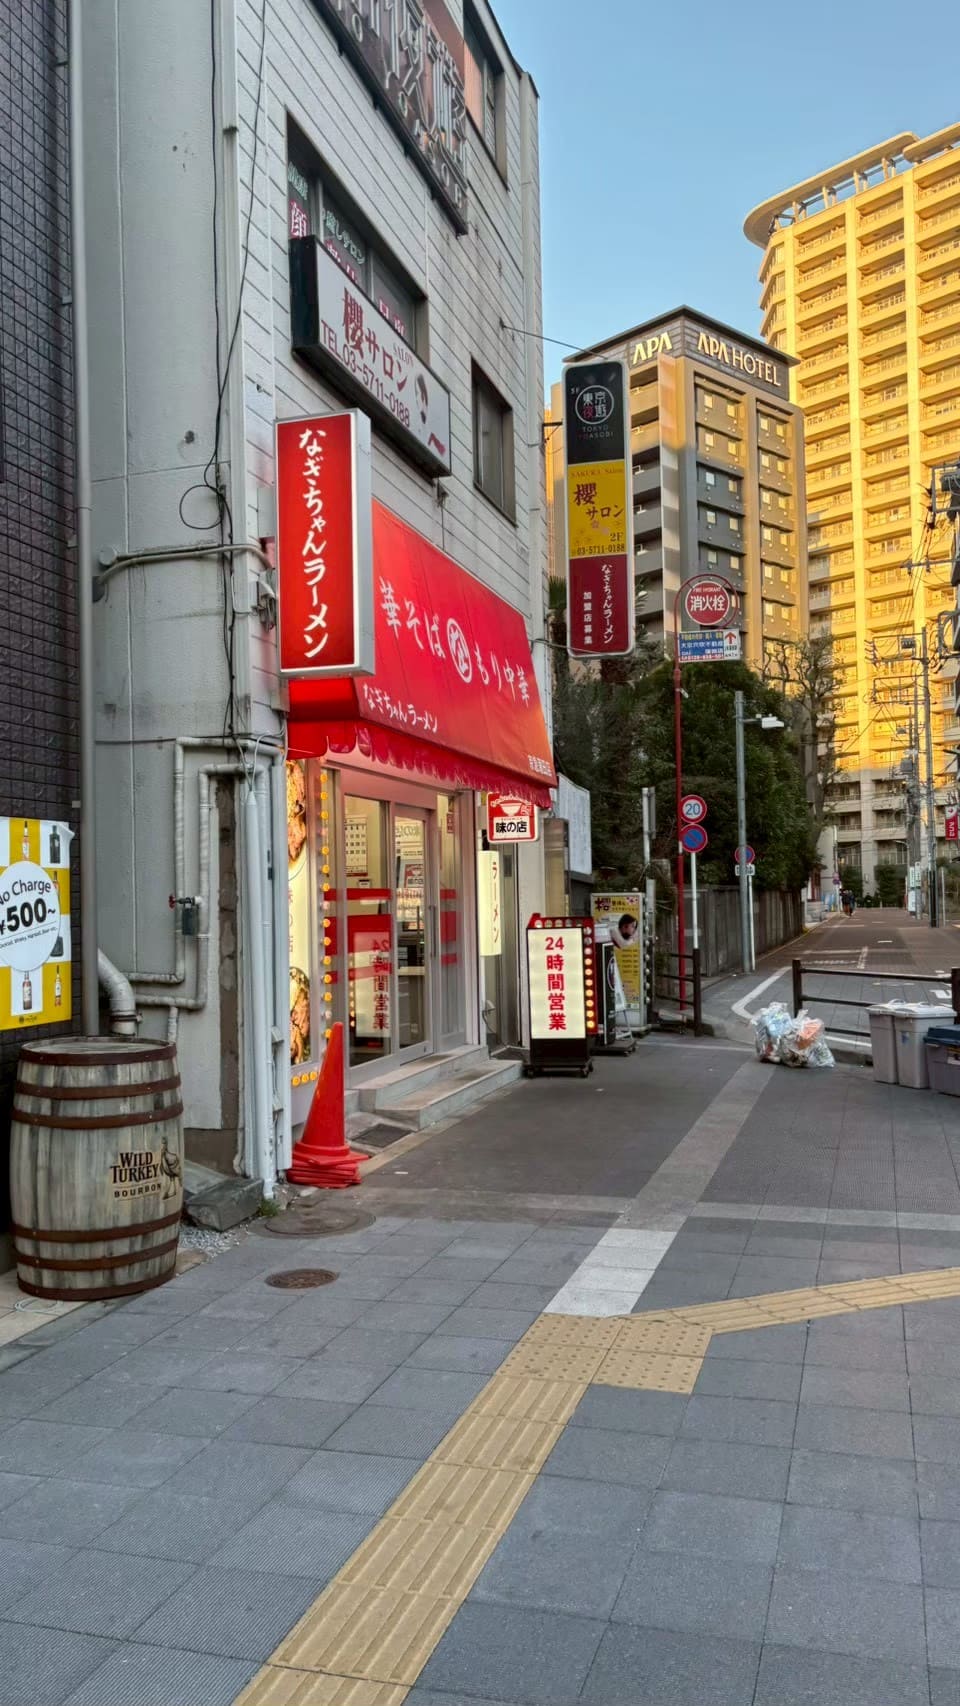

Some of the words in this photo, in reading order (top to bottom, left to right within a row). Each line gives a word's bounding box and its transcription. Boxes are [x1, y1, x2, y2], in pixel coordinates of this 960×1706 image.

[632, 332, 673, 365] APA
[697, 332, 730, 364] APA
[732, 346, 781, 387] HOTEL
[586, 504, 624, 520] サロン
[299, 427, 329, 659] なぎちゃんラーメン
[610, 532, 624, 542] 2F
[690, 595, 725, 612] 消火栓
[685, 803, 701, 816] 20
[495, 821, 527, 834] 味の店
[12, 879, 52, 896] Charge
[545, 936, 567, 1031] 24時間営業
[120, 1151, 153, 1168] WILD
[110, 1163, 160, 1184] TURKEY
[114, 1183, 162, 1198] BOURBON
